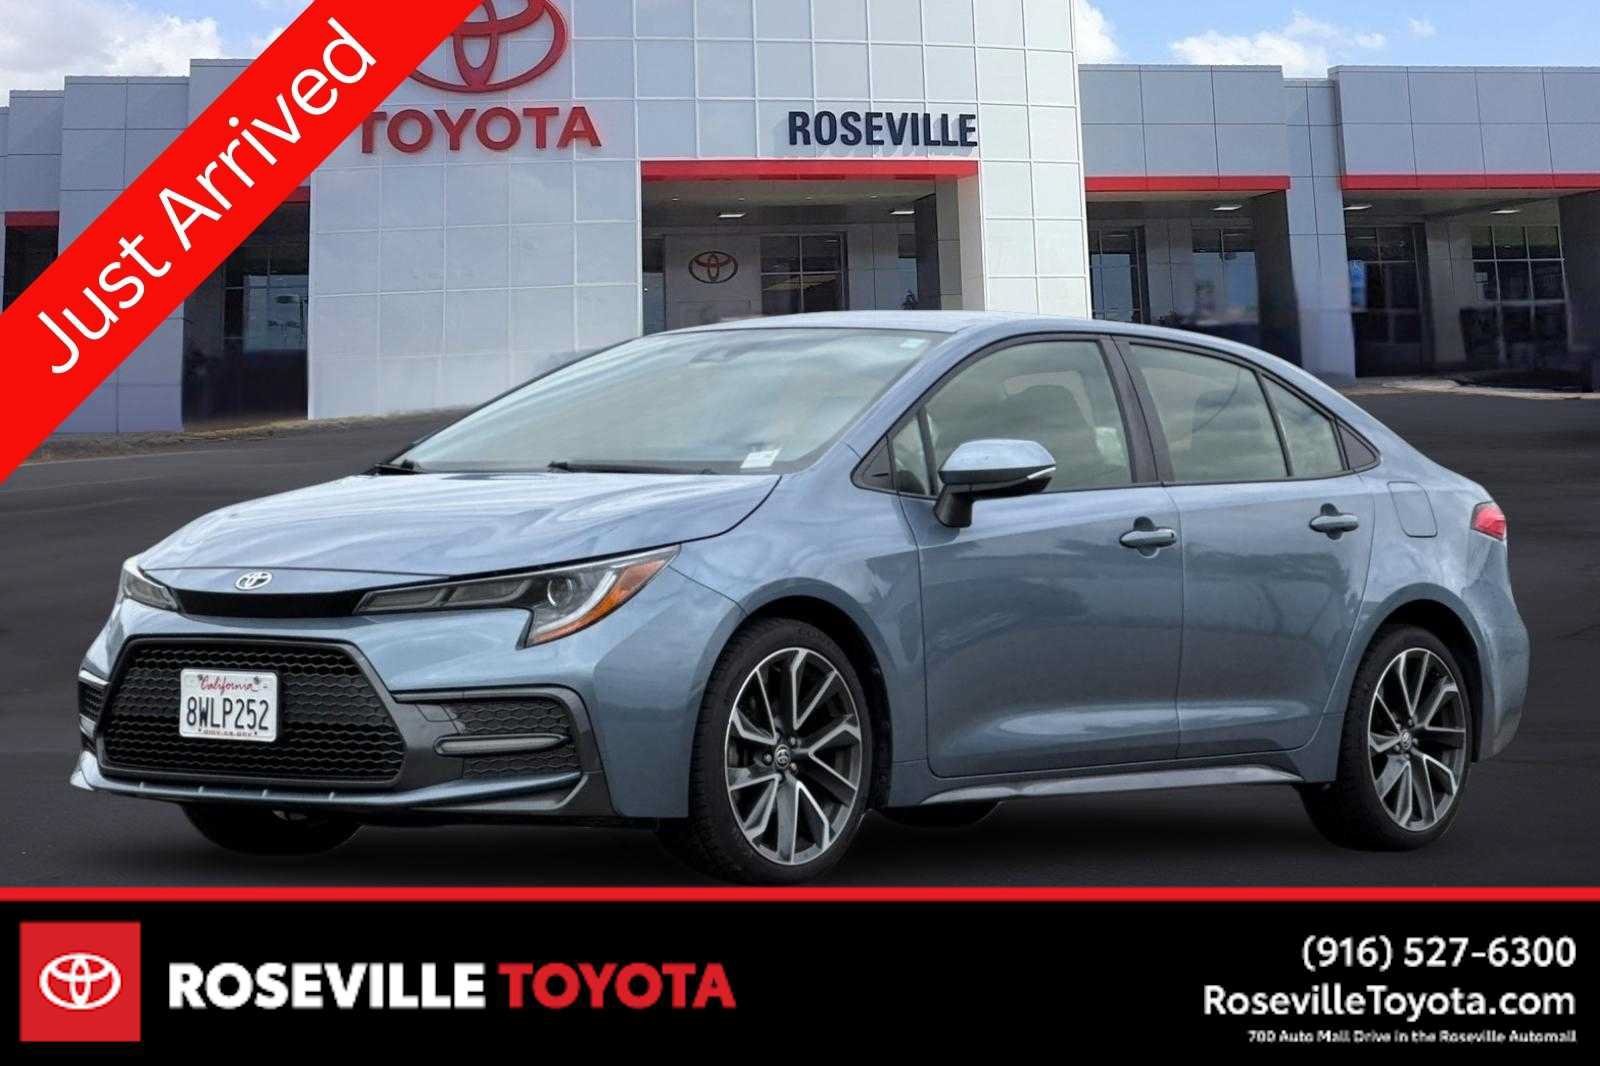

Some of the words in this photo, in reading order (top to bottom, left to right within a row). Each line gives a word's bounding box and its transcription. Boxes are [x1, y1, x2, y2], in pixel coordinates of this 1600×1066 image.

[361, 106, 602, 154] TOYOTA
[787, 110, 979, 148] ROSEVILLE
[200, 674, 258, 696] California
[186, 696, 270, 731] 8WLP252
